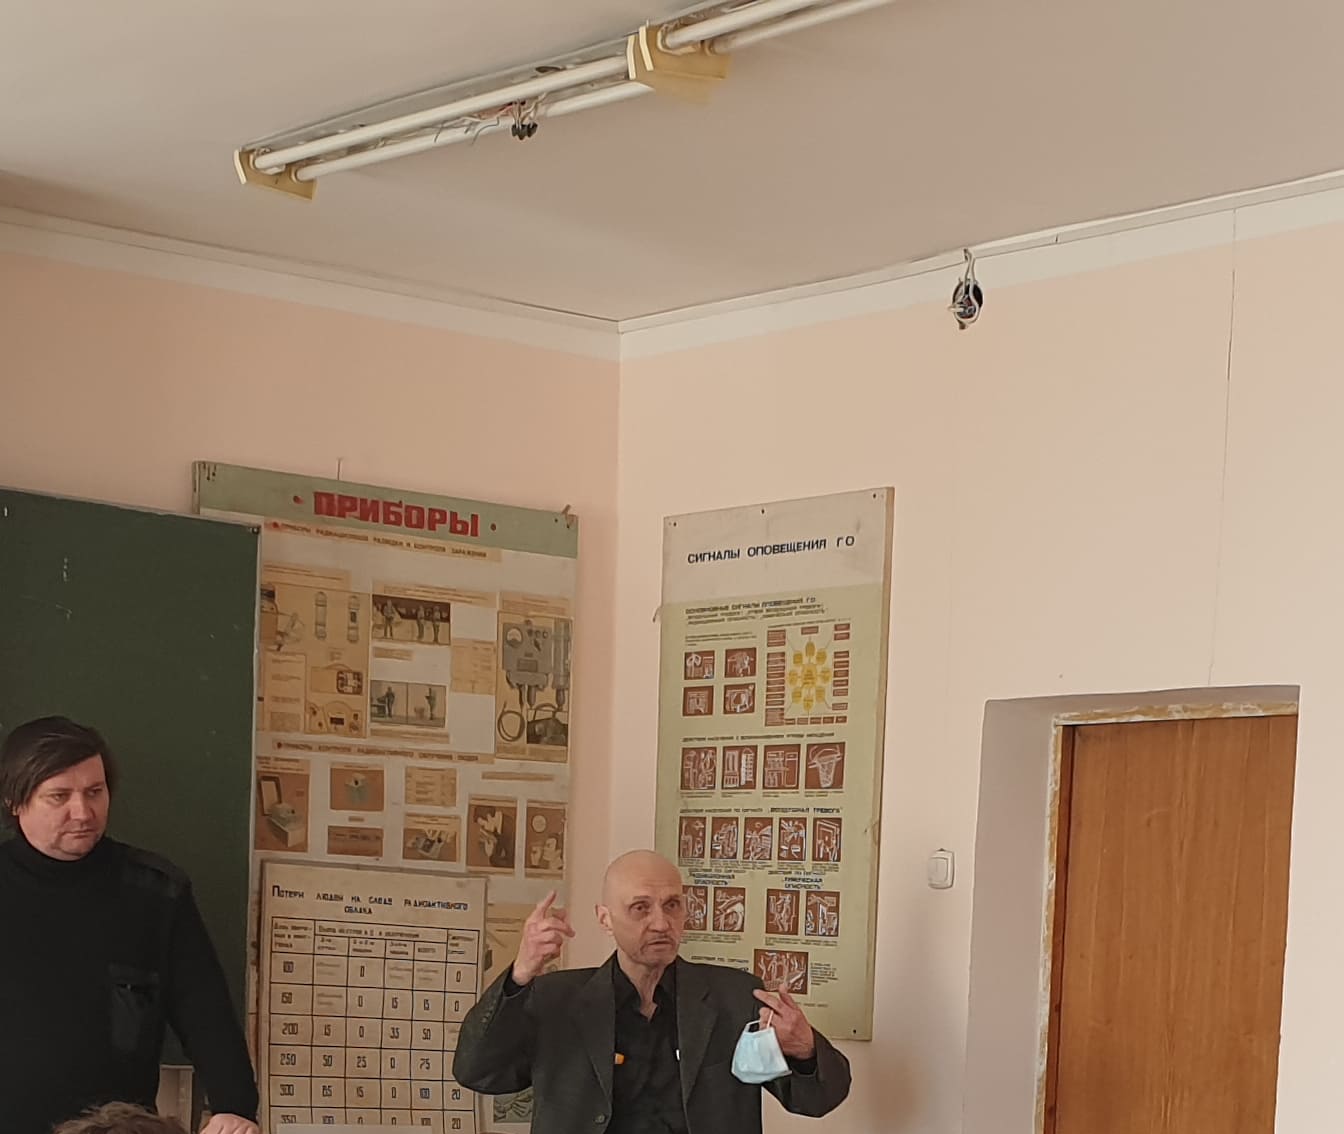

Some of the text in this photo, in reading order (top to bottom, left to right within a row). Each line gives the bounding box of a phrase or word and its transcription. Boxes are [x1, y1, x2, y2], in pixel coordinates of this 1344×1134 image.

[313, 491, 480, 537] ПРИБОРЫ
[687, 535, 855, 564] СИГНАЛЫ ОПОВЕЩЕНИЯ ГО
[282, 1023, 299, 1036] 200
[280, 1053, 297, 1066] 250
[356, 1056, 367, 1069] 25
[451, 1089, 461, 1101] 20
[451, 1117, 461, 1130] 20
